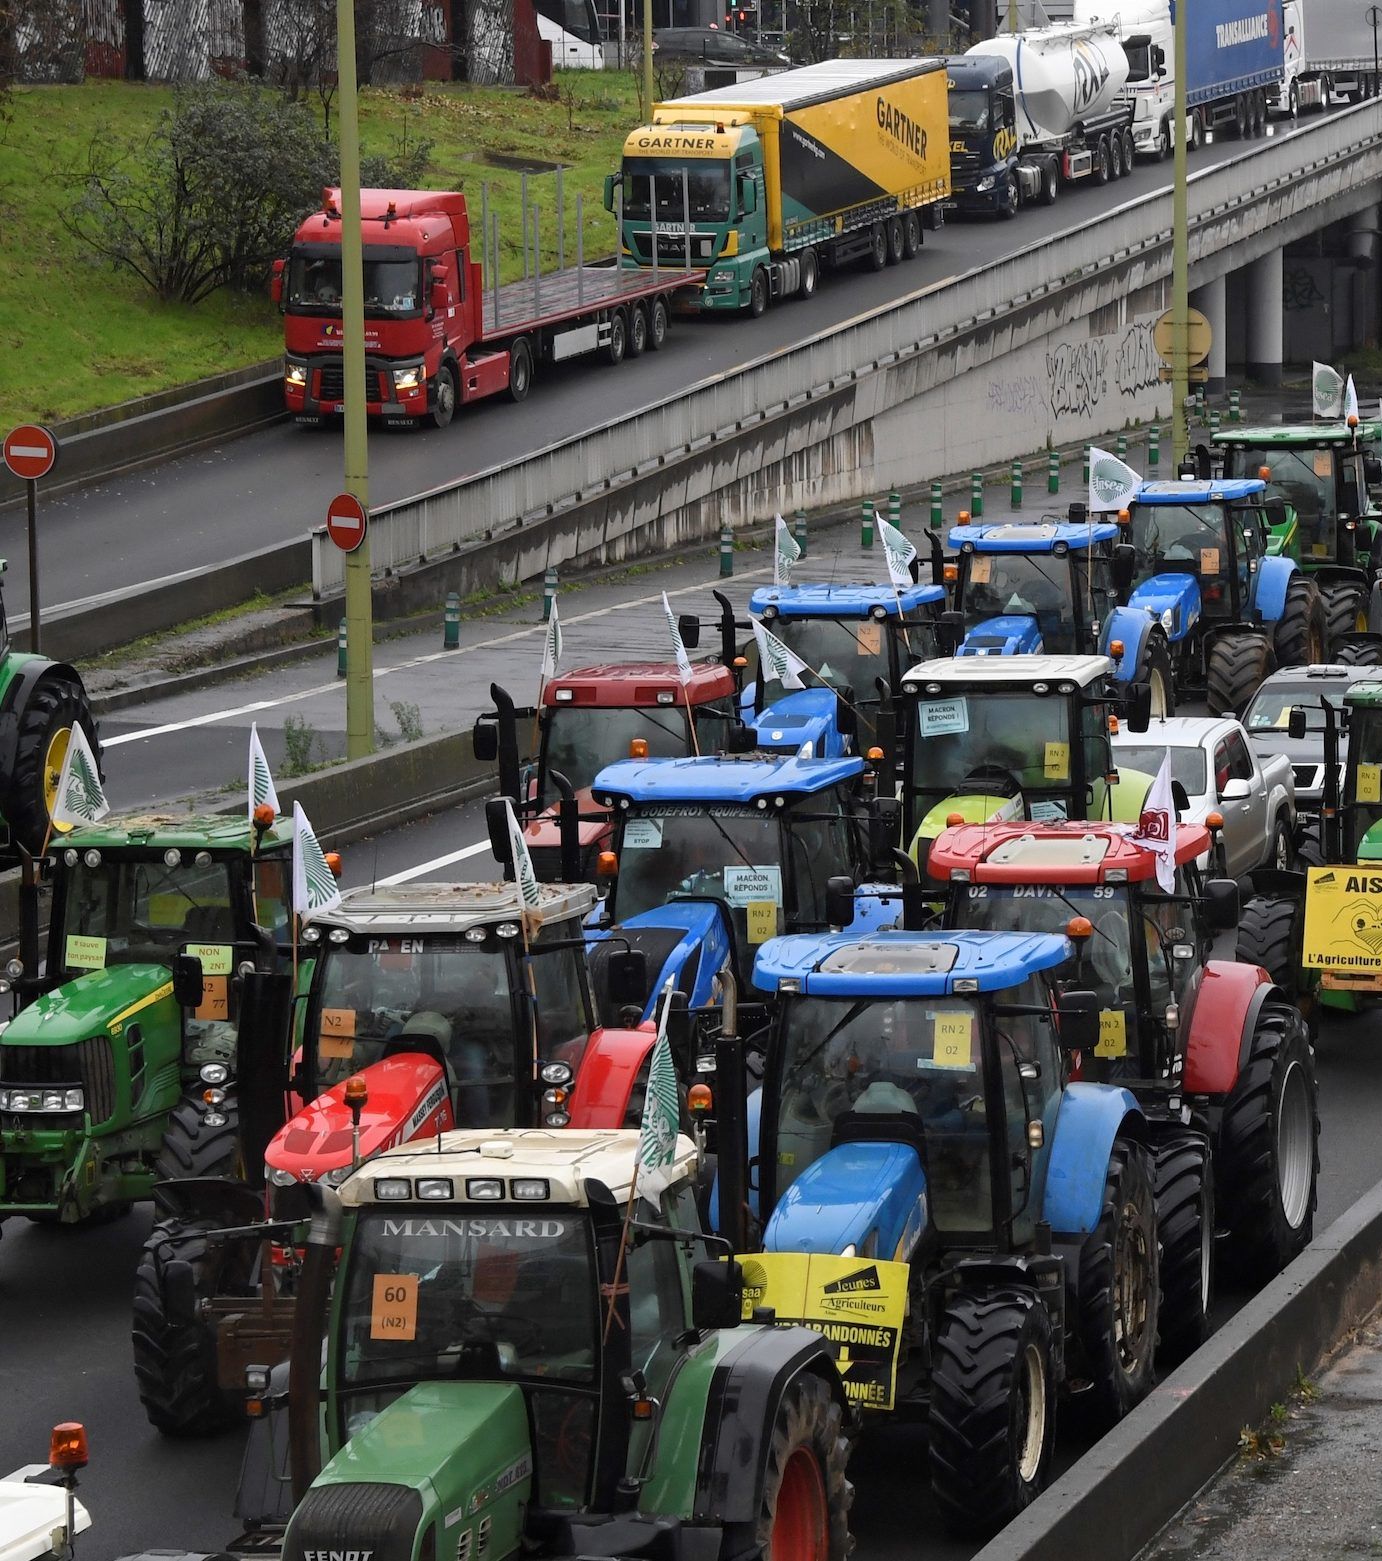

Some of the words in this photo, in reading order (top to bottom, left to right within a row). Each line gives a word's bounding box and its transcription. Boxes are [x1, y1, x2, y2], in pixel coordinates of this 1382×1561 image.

[1215, 13, 1268, 49] TRANSALLIANCE
[876, 96, 928, 161] GARTNER
[638, 137, 715, 149] GARTNER
[655, 222, 696, 232] ARTNR
[641, 806, 704, 818] GODEFROY
[708, 807, 777, 819] EQUIPEMENT
[968, 885, 988, 898] 02
[1012, 885, 1066, 898] DAVID
[1093, 886, 1115, 899] 59
[752, 910, 764, 918] RN
[766, 910, 771, 918] 2
[756, 926, 767, 935] 02
[80, 941, 99, 949] sauve
[68, 952, 79, 960] ton
[79, 953, 104, 962] paysan
[199, 948, 220, 956] NON
[1308, 953, 1382, 967] L'Agriculture
[212, 999, 226, 1009] 77
[324, 1015, 342, 1027] N2
[1099, 1020, 1112, 1029] RN
[1114, 1020, 1120, 1029] 2
[941, 1024, 958, 1034] RN
[958, 1024, 965, 1034] 2
[1104, 1038, 1115, 1048] 02
[945, 1045, 958, 1055] 02
[381, 1219, 565, 1238] MANSARD
[836, 1275, 876, 1293] Jeunes
[384, 1286, 407, 1303] 60
[827, 1297, 886, 1313] Agriculteurs
[381, 1315, 407, 1330] (N2)
